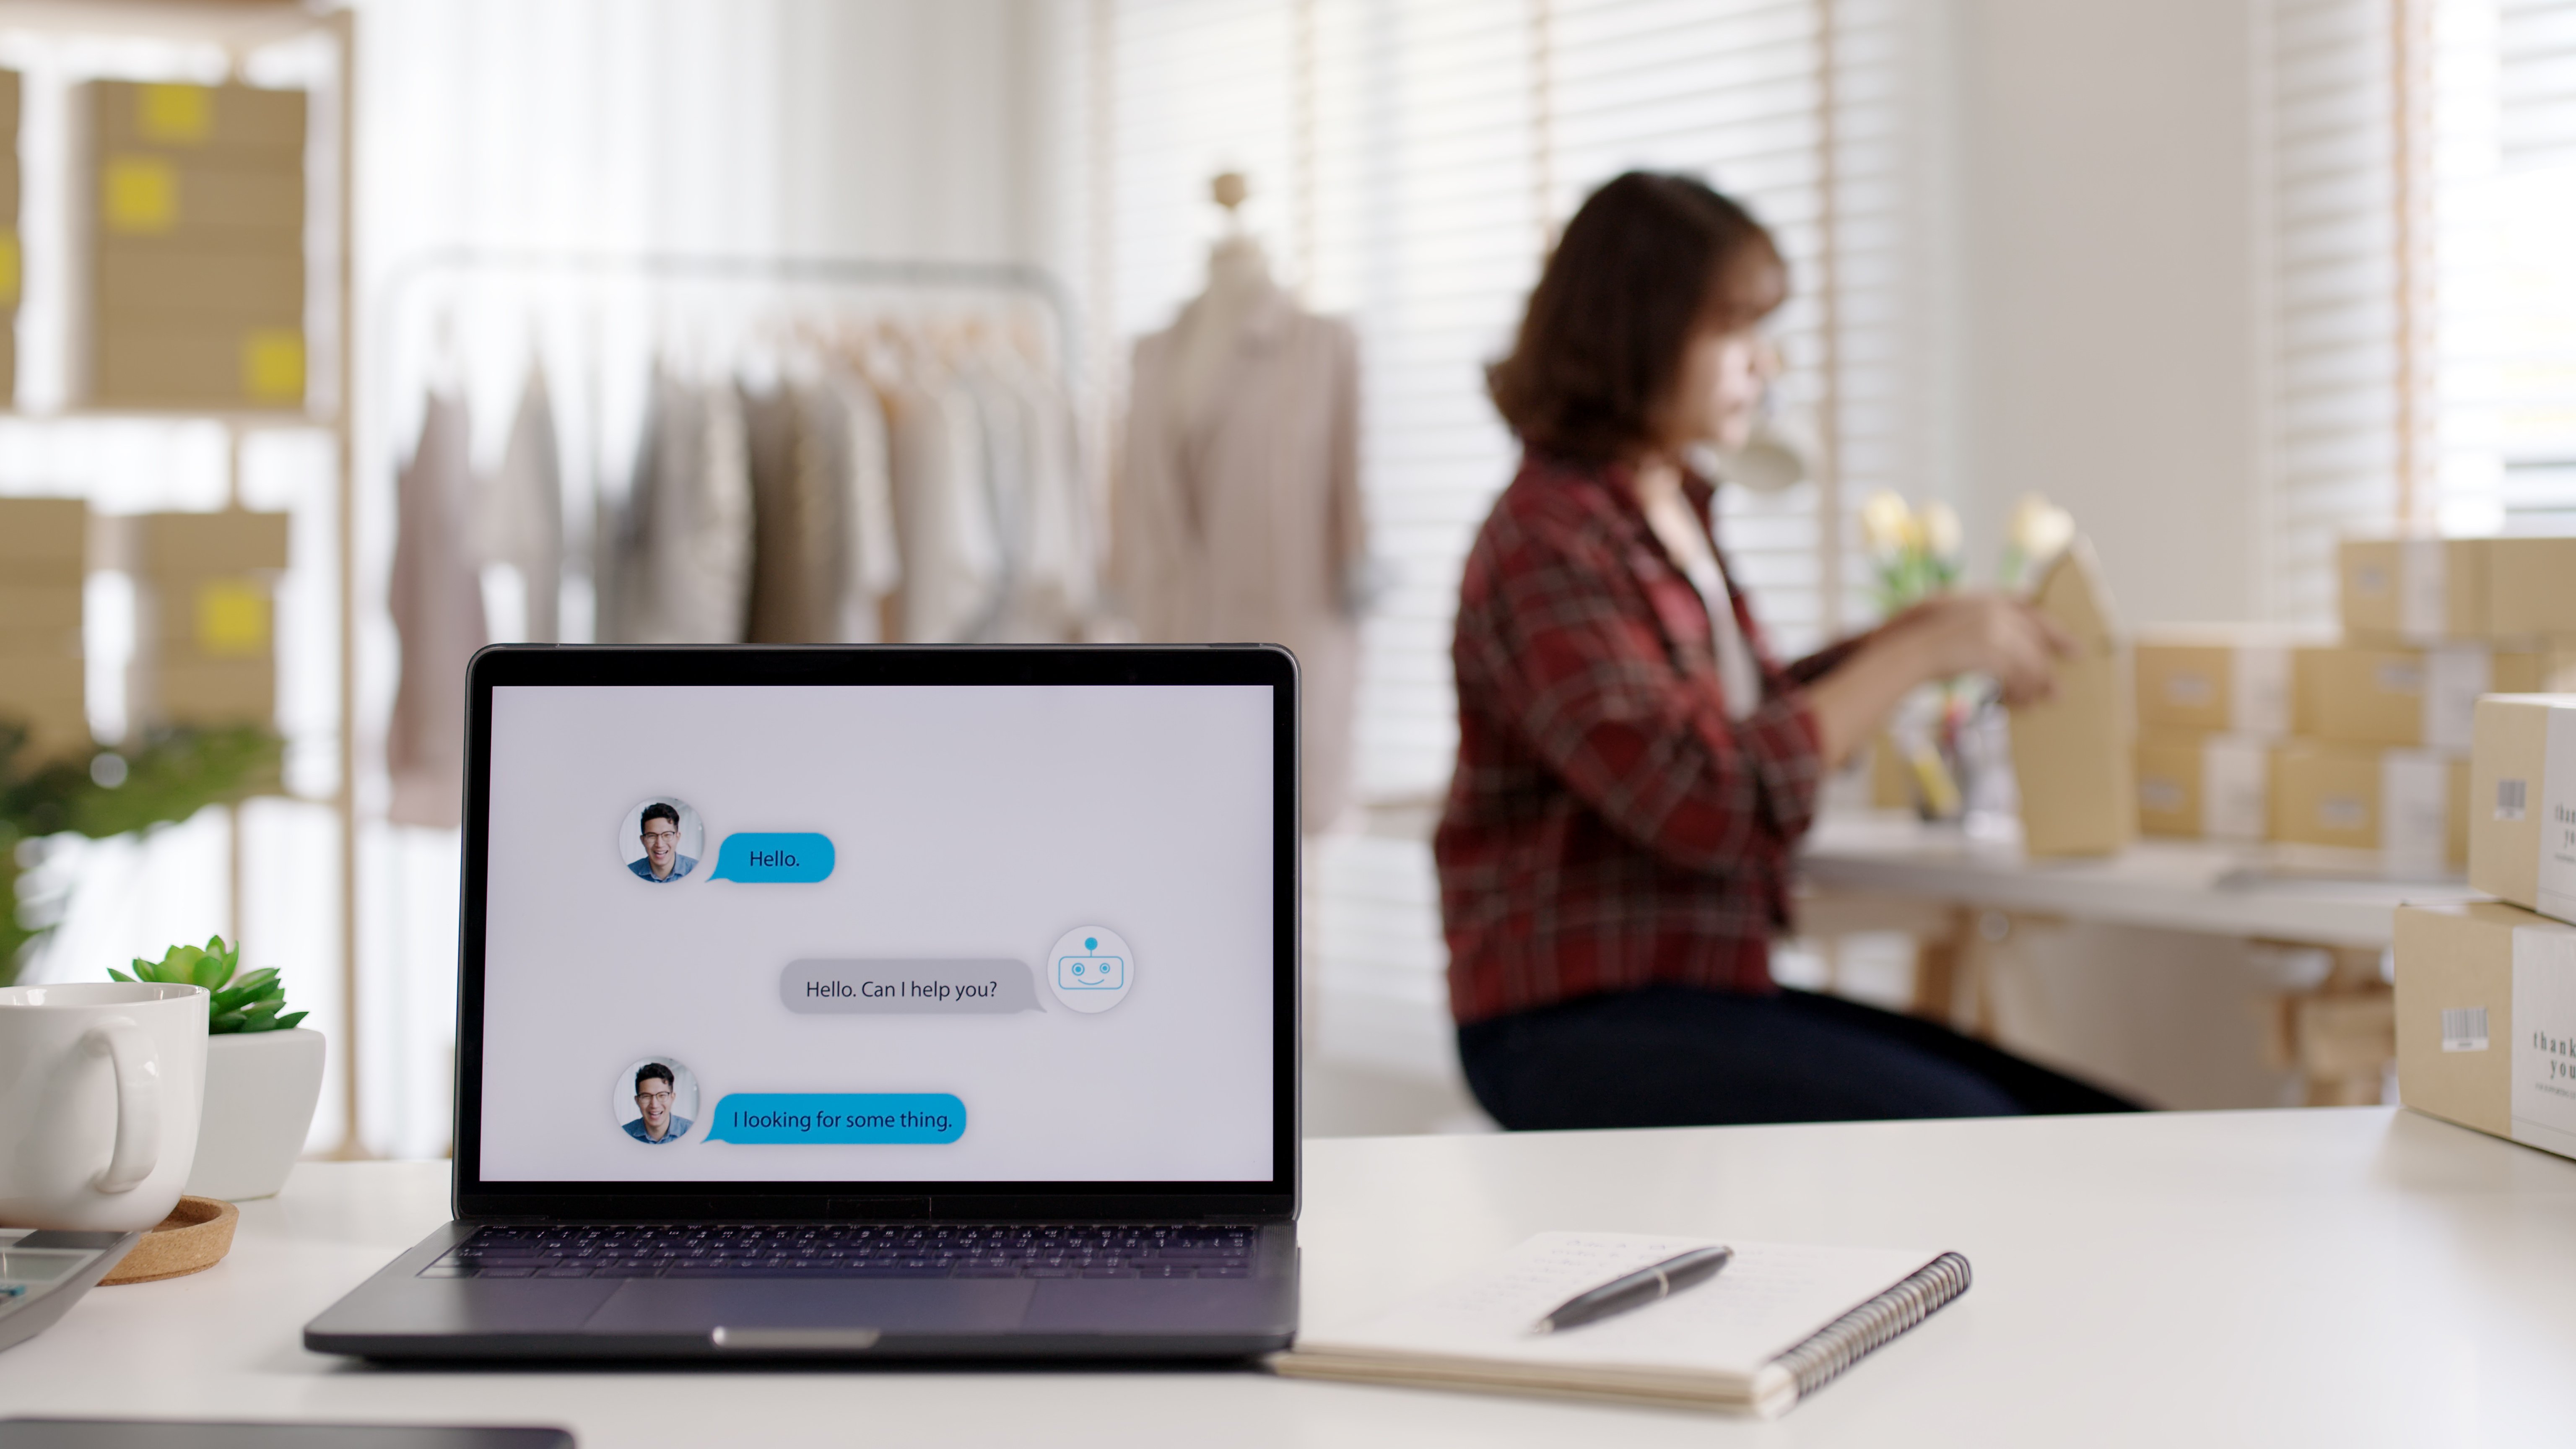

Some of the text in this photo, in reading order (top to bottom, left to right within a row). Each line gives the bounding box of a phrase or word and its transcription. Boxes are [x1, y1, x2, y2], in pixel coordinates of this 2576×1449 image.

[750, 850, 800, 867] Hello.
[807, 980, 997, 1002] Hello. Can I help you?
[2534, 1031, 2576, 1058] thank
[2550, 1059, 2576, 1080] you
[734, 1110, 952, 1132] I looking for some thing.
